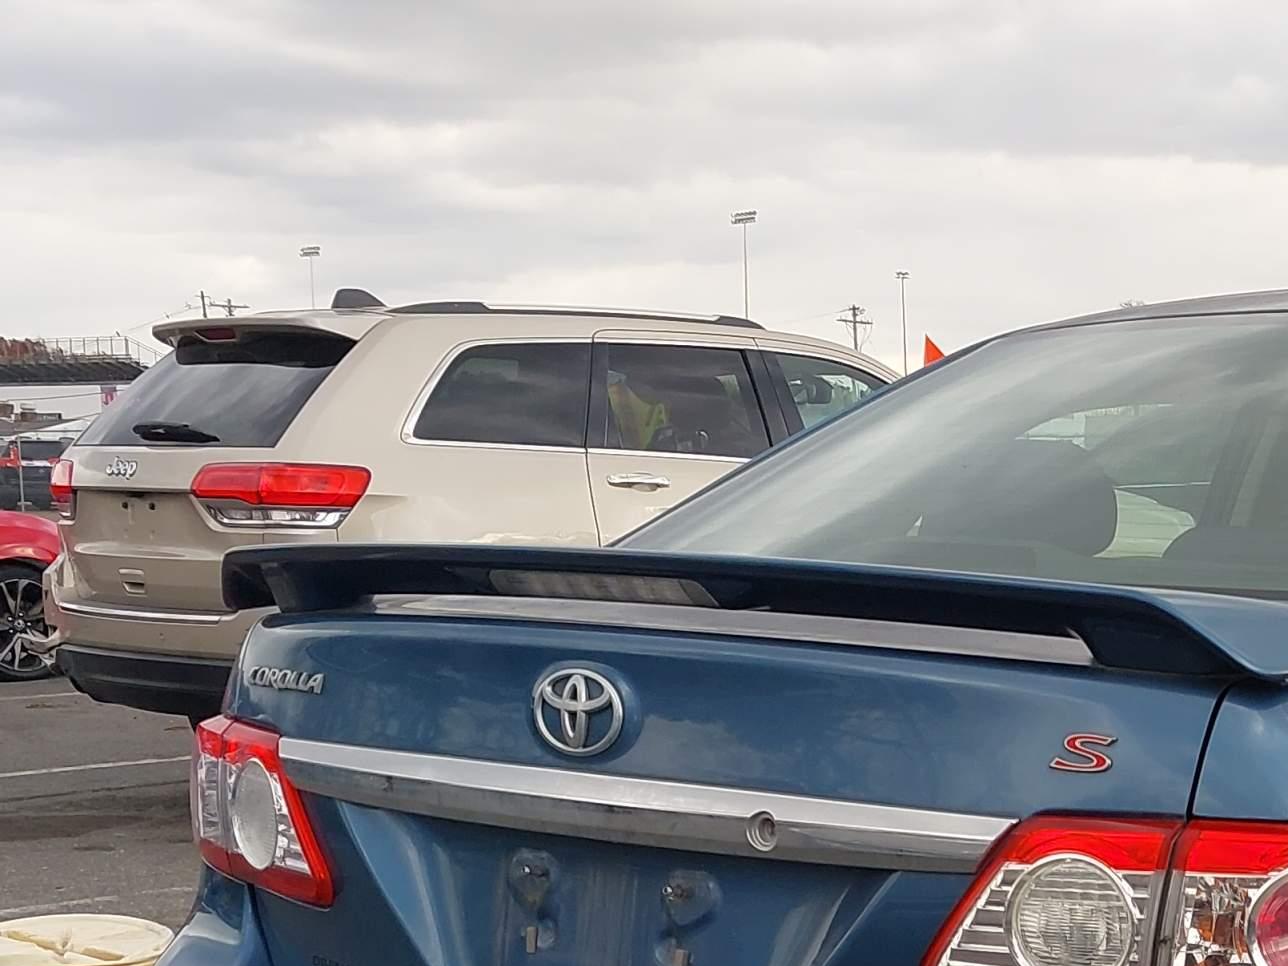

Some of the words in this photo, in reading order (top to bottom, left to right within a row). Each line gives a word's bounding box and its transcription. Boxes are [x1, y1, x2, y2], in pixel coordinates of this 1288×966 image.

[106, 456, 138, 480] Jeep
[248, 665, 325, 695] COROLLA
[1049, 732, 1118, 774] S
